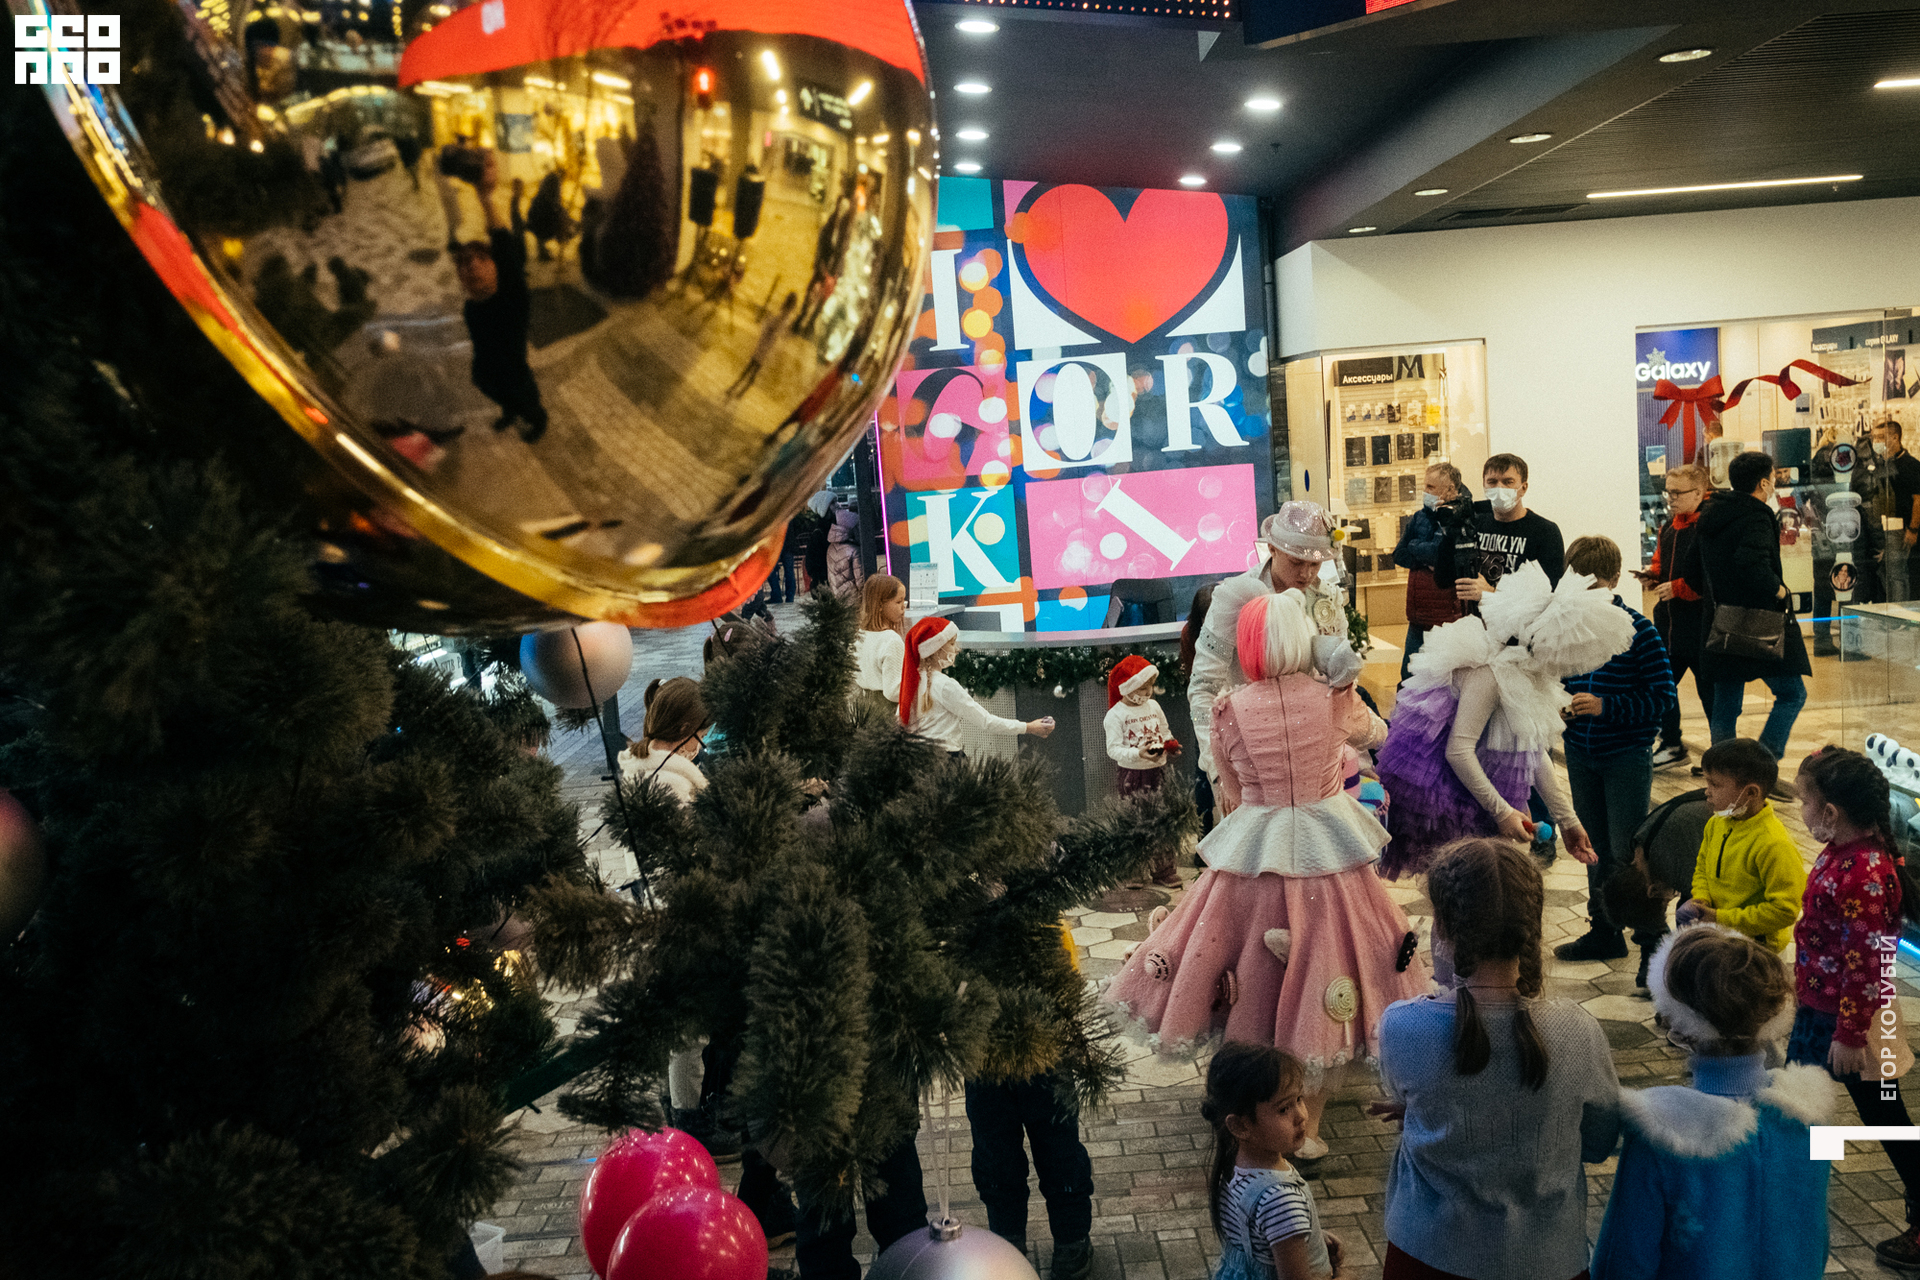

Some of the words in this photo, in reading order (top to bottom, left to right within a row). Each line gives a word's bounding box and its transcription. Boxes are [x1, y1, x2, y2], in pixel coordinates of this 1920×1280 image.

[1342, 373, 1393, 384] Аксессуары
[1635, 361, 1711, 381] Galaxy
[1477, 532, 1527, 555] OOKLYN
